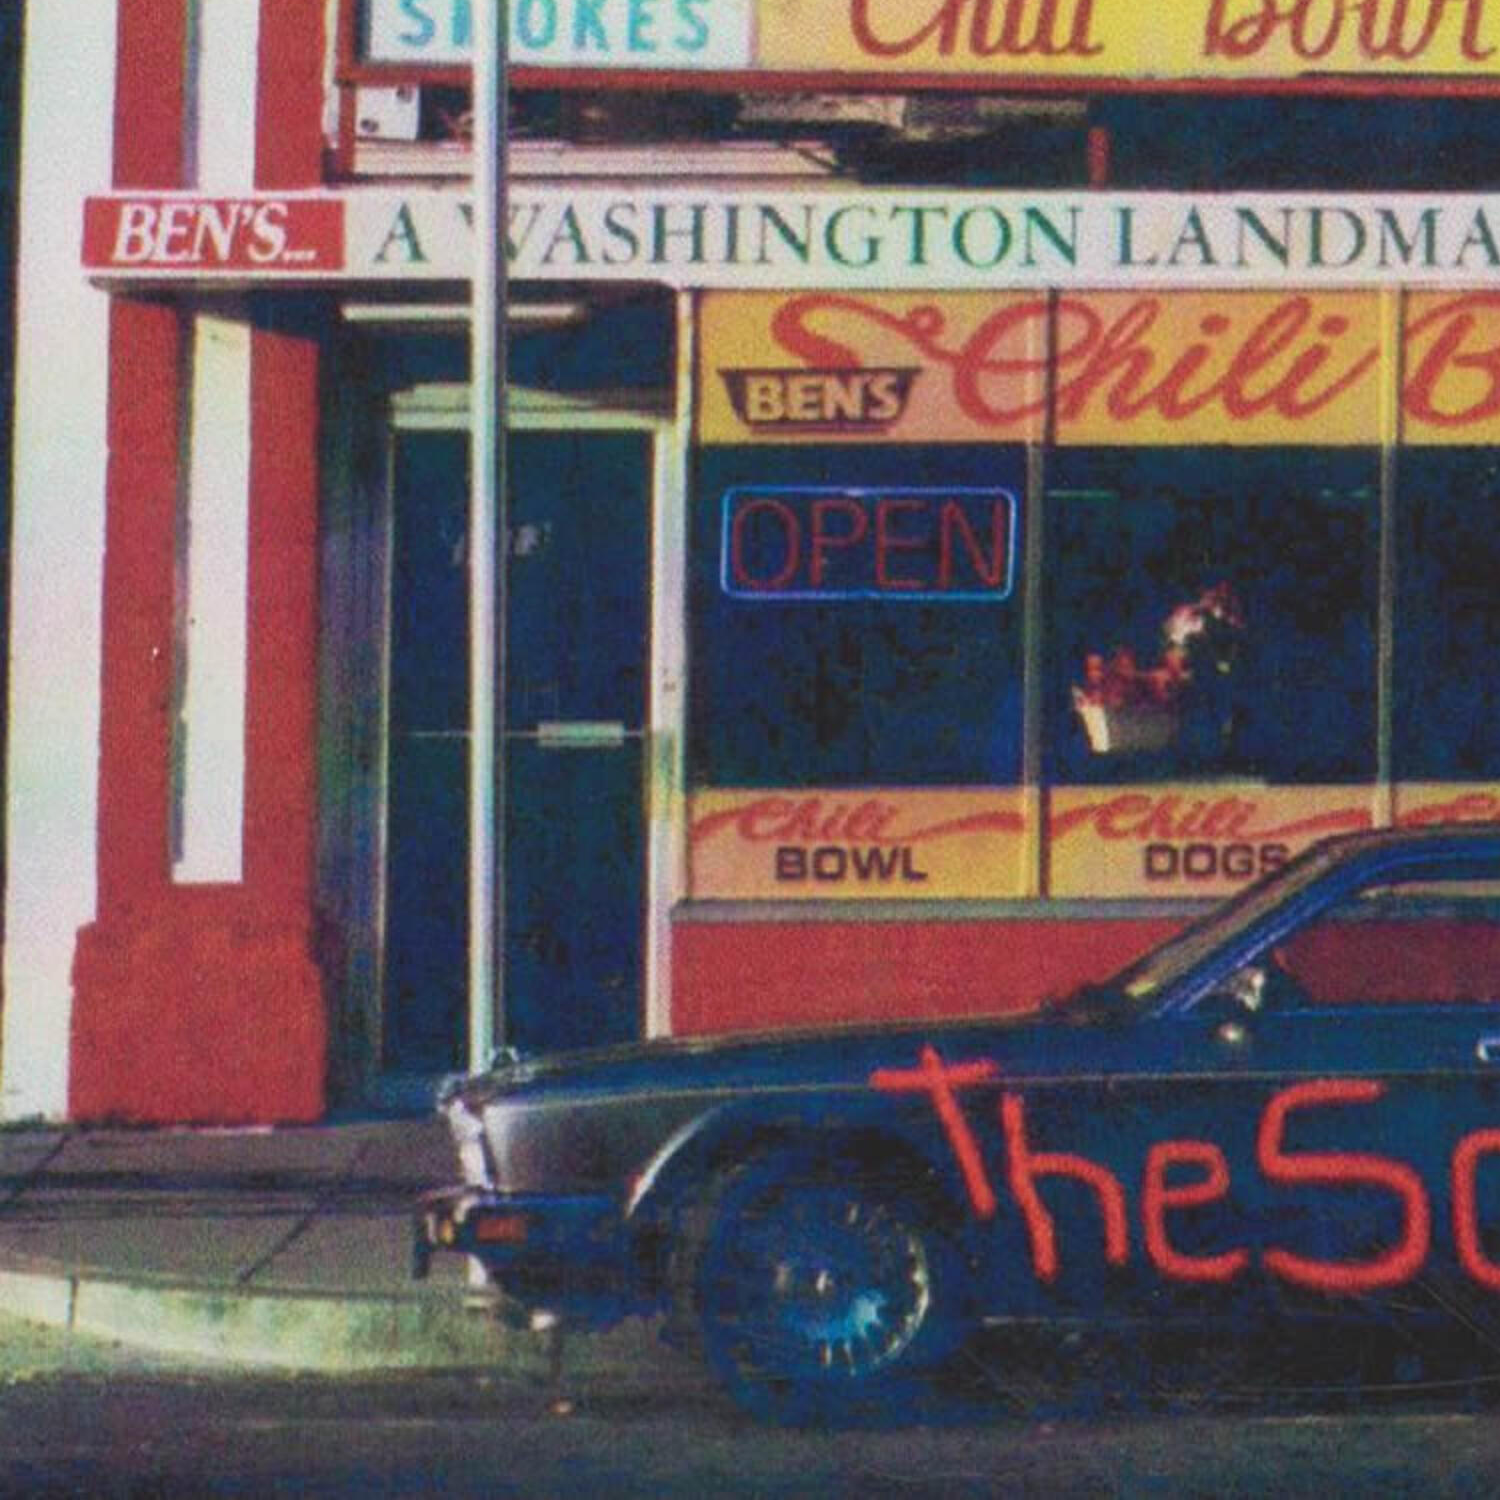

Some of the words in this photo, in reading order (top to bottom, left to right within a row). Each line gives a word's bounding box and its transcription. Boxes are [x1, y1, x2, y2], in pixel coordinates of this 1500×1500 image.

[373, 201, 428, 263] A
[945, 297, 1382, 424] Chili
[730, 498, 1003, 590] OPEN
[737, 797, 901, 843] Chili
[1091, 793, 1257, 841] Chili
[775, 846, 928, 881] BOWL
[1144, 843, 1288, 881] DOGS
